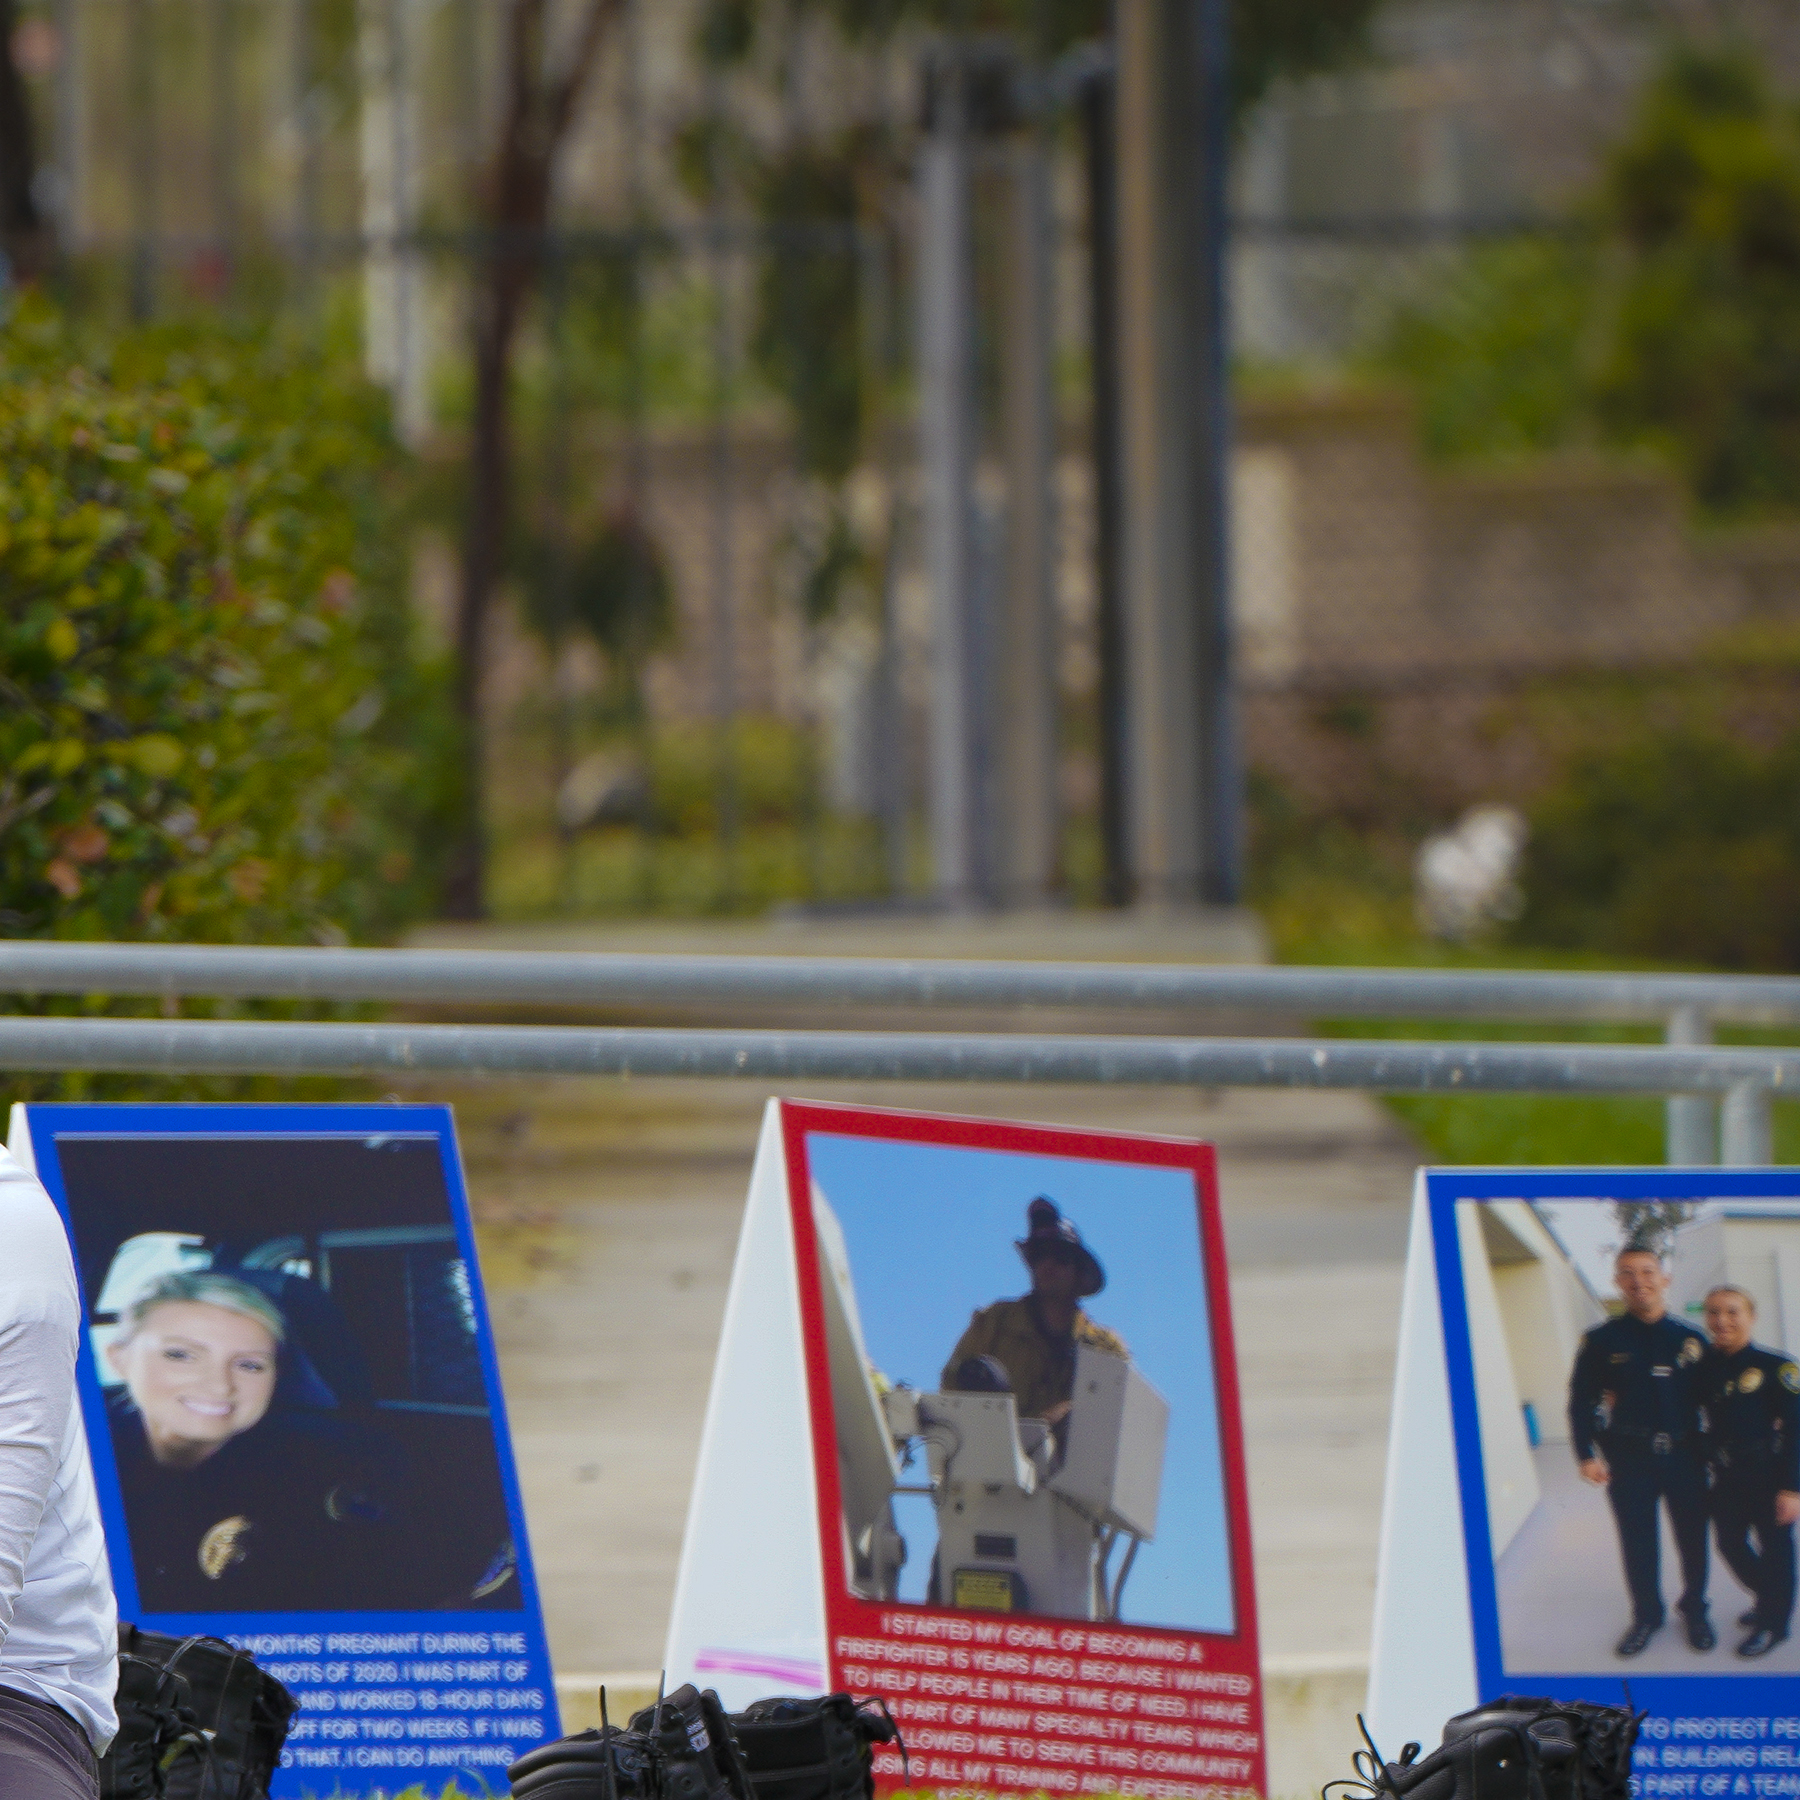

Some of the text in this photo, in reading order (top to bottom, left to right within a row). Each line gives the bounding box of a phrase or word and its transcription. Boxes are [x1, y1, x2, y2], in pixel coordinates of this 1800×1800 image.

[326, 1633, 418, 1654] PREGNANT
[423, 1633, 489, 1654] DURING
[491, 1633, 527, 1654] THE
[891, 1614, 974, 1641] STARTED
[977, 1622, 1005, 1644] MY
[1007, 1625, 1057, 1648] GOAL
[1060, 1630, 1086, 1651] OF
[1089, 1633, 1185, 1660] BECOMING
[326, 1661, 351, 1682] OF
[411, 1661, 451, 1682] WAS
[455, 1661, 501, 1682] PART
[504, 1661, 529, 1682] OF
[838, 1637, 951, 1666] FIREFIGHTER
[954, 1648, 972, 1668] 15
[975, 1650, 1033, 1674] YEARS
[1083, 1660, 1164, 1687] BECAUSE
[1177, 1669, 1250, 1696] WANTED
[299, 1690, 337, 1711] AND
[339, 1690, 417, 1711] WORKED
[496, 1690, 544, 1711] DAYS
[844, 1666, 869, 1687] TO
[872, 1669, 916, 1692] HELP
[920, 1673, 987, 1699] PEOPLE
[990, 1680, 1008, 1701] IN
[1011, 1682, 1063, 1706] THEIR
[1066, 1687, 1107, 1710] TIME
[1110, 1691, 1134, 1712] OF
[1137, 1693, 1189, 1718] NEED.
[1202, 1699, 1248, 1723] HAVE
[326, 1717, 361, 1739] FOR
[363, 1717, 404, 1739] TWO
[476, 1717, 492, 1739] IF
[504, 1717, 544, 1739] WAS
[902, 1701, 949, 1724] PART
[952, 1705, 978, 1726] OF
[981, 1708, 1032, 1731] MANY
[1035, 1712, 1131, 1741] SPECIALTY
[1134, 1721, 1194, 1747] TEAMS
[1198, 1727, 1257, 1753] WHICH
[1640, 1717, 1671, 1739] TO
[1673, 1717, 1769, 1739] PROTECT
[361, 1745, 397, 1767] CAN
[399, 1745, 425, 1767] DO
[977, 1737, 1004, 1759] ME
[1007, 1740, 1032, 1761] TO
[1036, 1742, 1095, 1766] SERVE
[1099, 1747, 1139, 1770] THIS
[1143, 1751, 1250, 1779] COMMUNITY
[1661, 1745, 1757, 1767] BUILDING
[930, 1761, 961, 1781] ALL
[964, 1764, 991, 1783] MY
[994, 1767, 1076, 1789] TRAINING
[1079, 1774, 1116, 1792] AND
[1643, 1773, 1698, 1795] PART
[1700, 1773, 1730, 1795] OF
